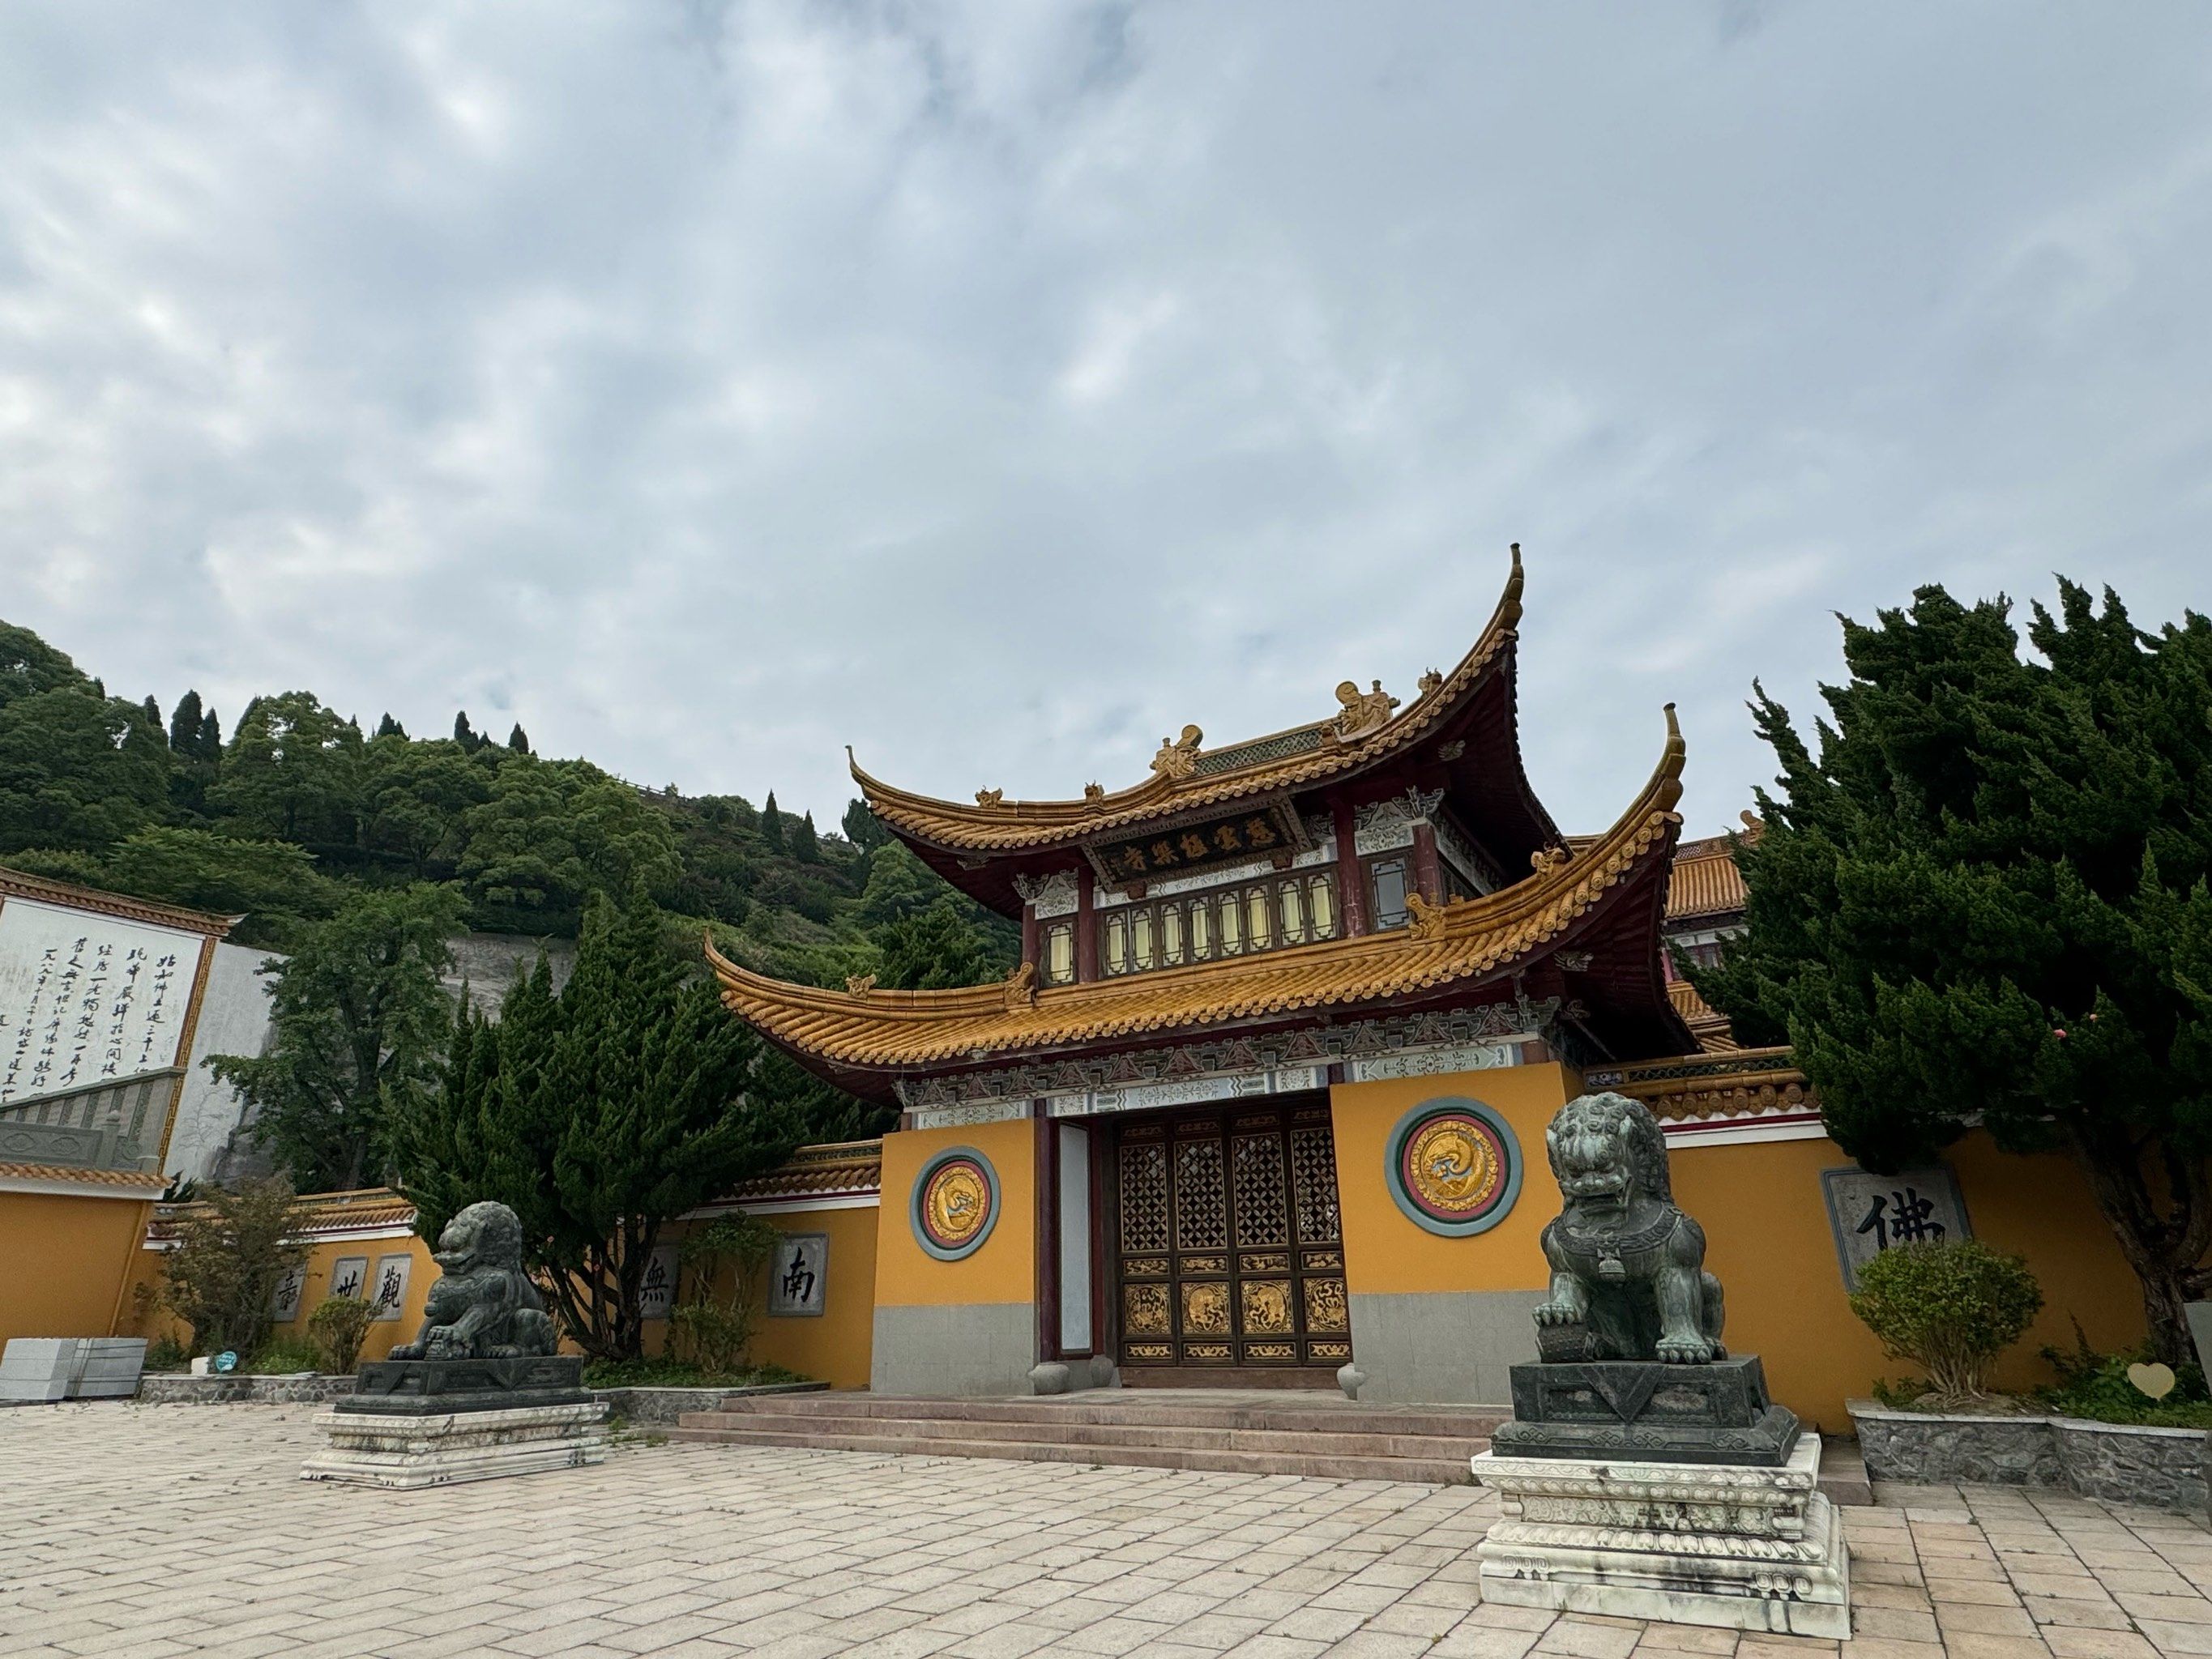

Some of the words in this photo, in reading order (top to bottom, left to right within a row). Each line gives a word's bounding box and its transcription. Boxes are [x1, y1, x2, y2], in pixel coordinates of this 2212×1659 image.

[1856, 1187, 1946, 1250] 佛
[376, 1265, 402, 1308] 觀
[639, 1256, 669, 1303] 無
[783, 1247, 815, 1302] 南
